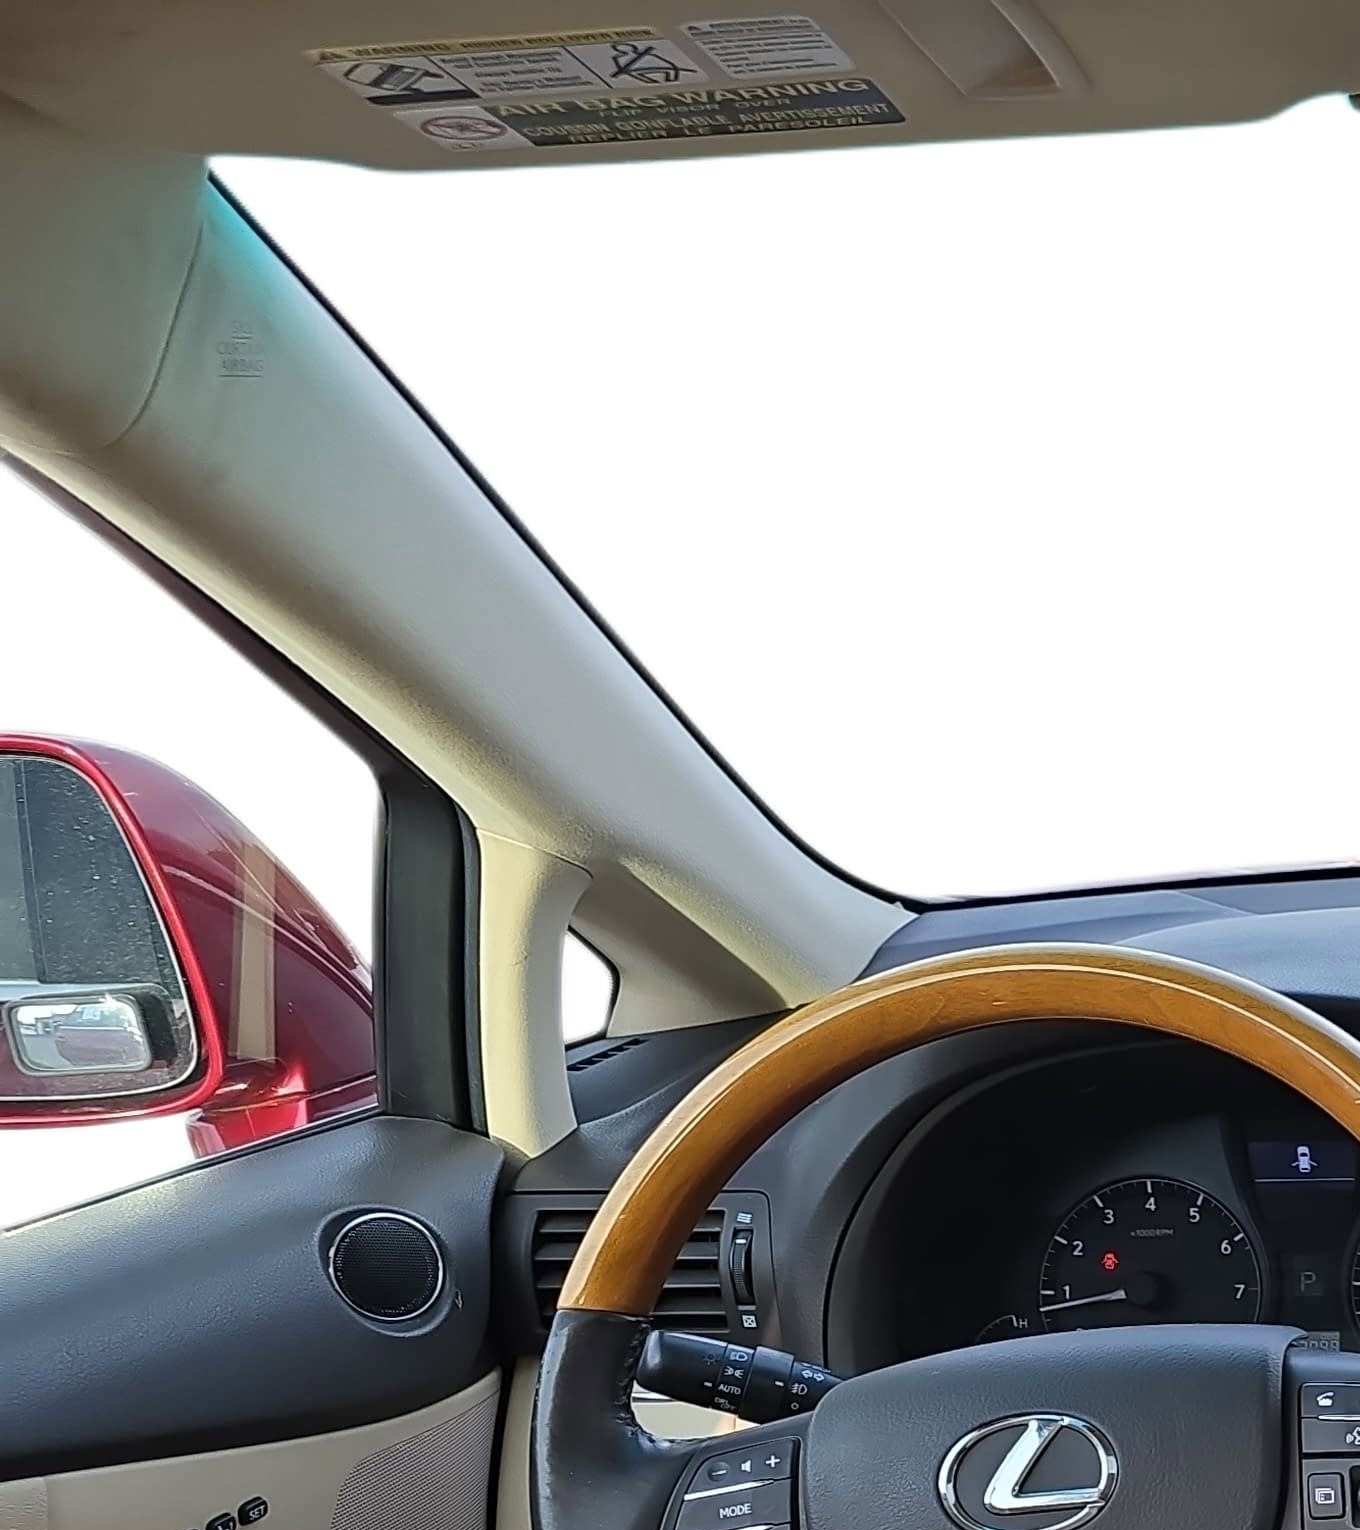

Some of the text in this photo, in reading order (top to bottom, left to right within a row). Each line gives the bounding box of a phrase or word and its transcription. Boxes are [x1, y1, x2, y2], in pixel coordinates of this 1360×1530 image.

[499, 78, 871, 118] AIR BAG WARNING
[597, 107, 639, 118] FLIP
[736, 97, 791, 109] OVER
[522, 122, 609, 138] COUSSIN
[739, 102, 890, 122] AVERTISSEMENT
[684, 126, 709, 136] LE
[1145, 1196, 1156, 1211] 4
[1103, 1209, 1115, 1224] 3
[1189, 1207, 1200, 1223] 5
[1072, 1240, 1084, 1256] 2
[1220, 1239, 1232, 1255] 6
[1300, 1271, 1316, 1292] P
[1062, 1284, 1071, 1300] 1
[1234, 1283, 1246, 1300] 7
[1018, 1318, 1028, 1329] H
[718, 1383, 742, 1396] AUTO
[249, 1505, 266, 1521] SET
[719, 1503, 753, 1519] MODE
